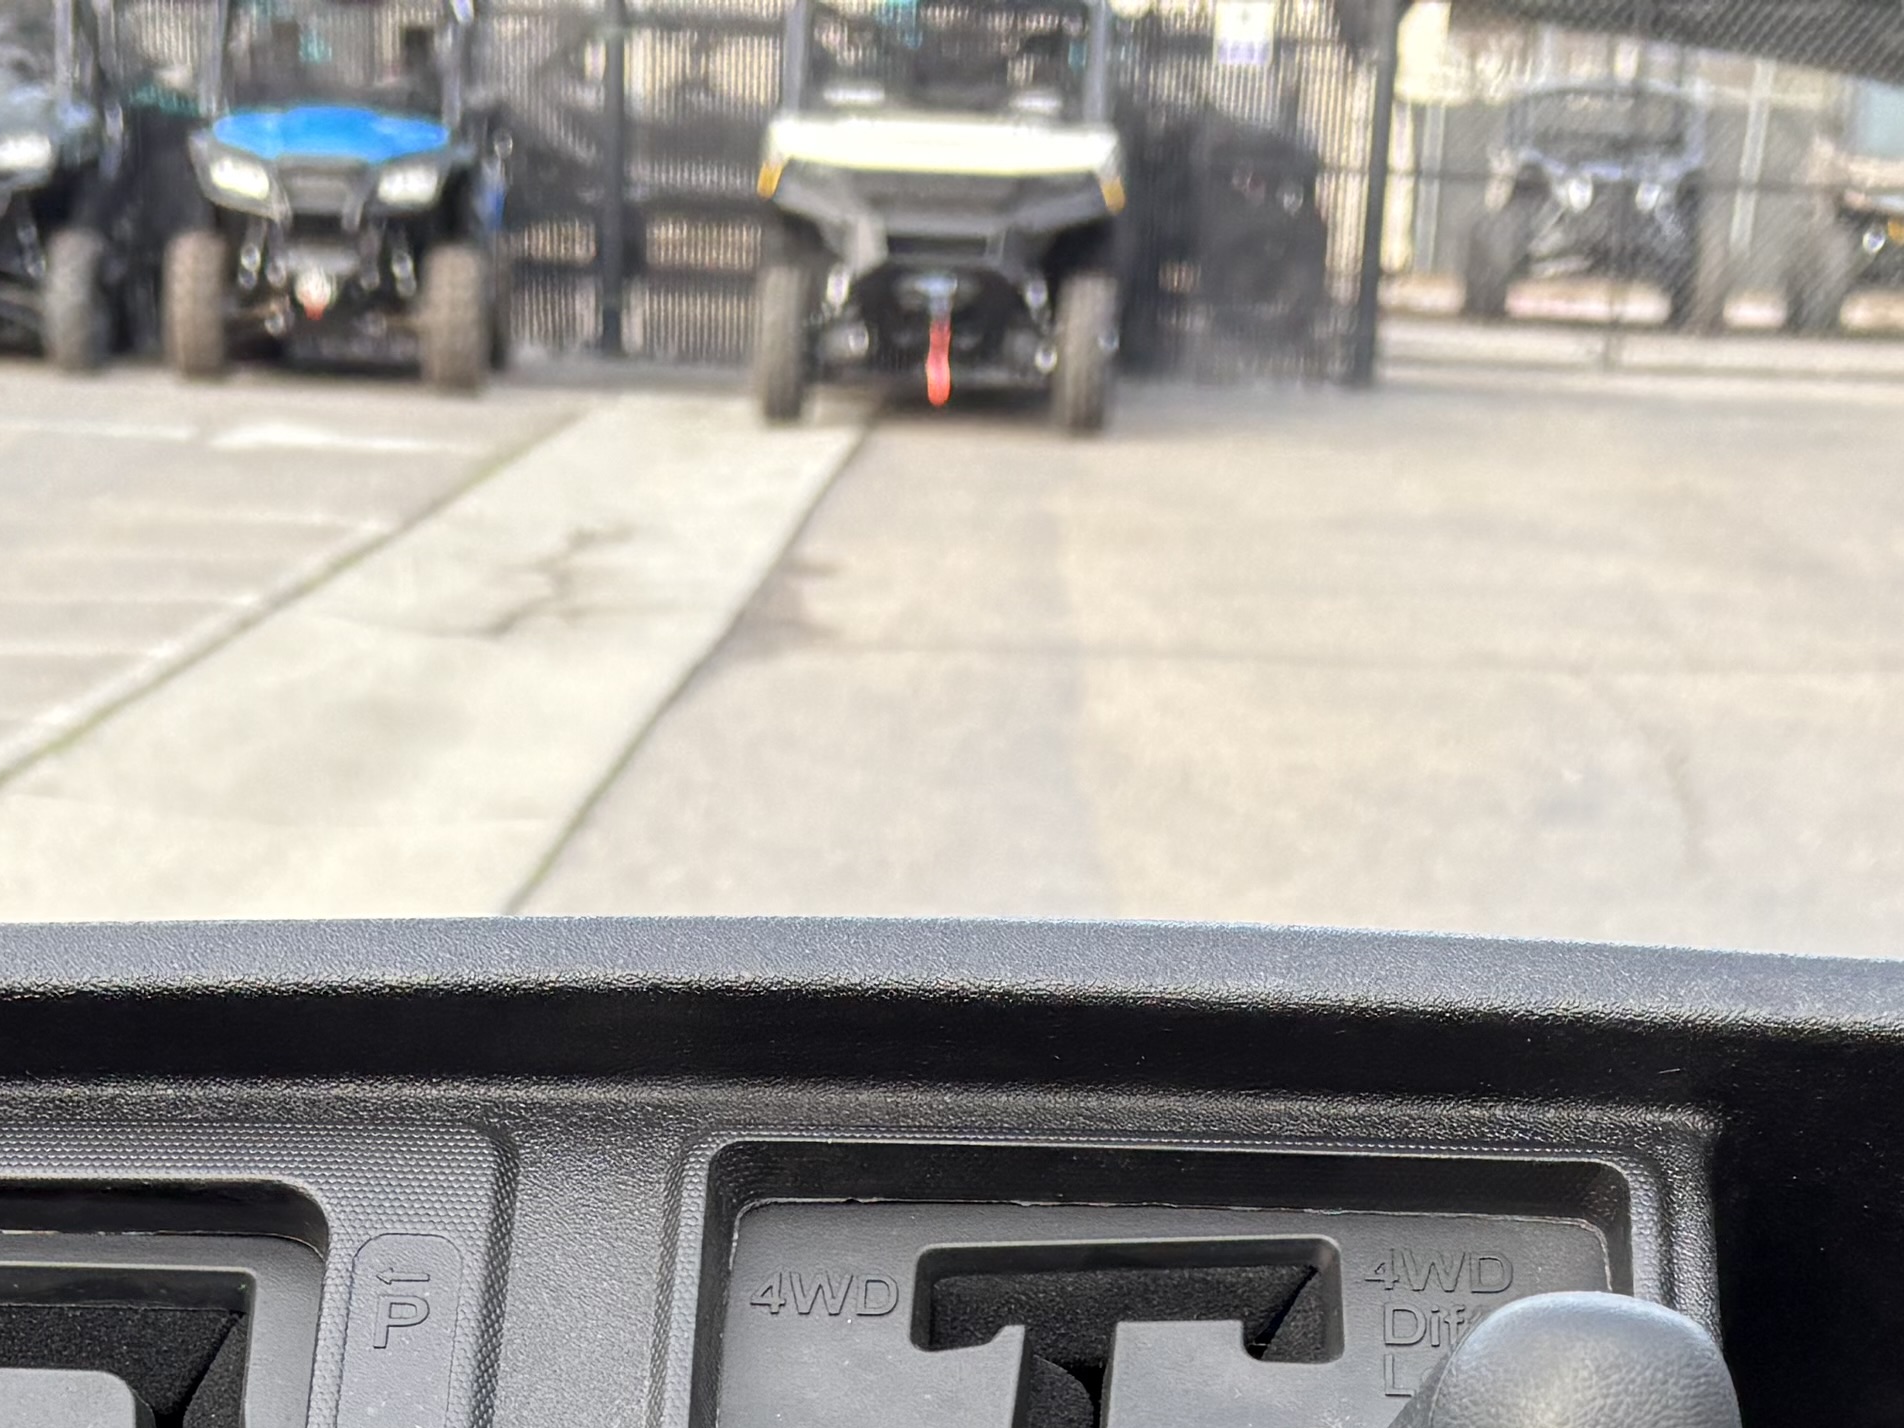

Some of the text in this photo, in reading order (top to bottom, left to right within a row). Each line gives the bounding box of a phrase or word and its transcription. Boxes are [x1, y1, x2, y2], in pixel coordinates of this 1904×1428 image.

[749, 1267, 899, 1317] 4WD
[1364, 1248, 1514, 1294] 4WD
[373, 1294, 431, 1350] P
[1382, 1301, 1470, 1348] Dif
